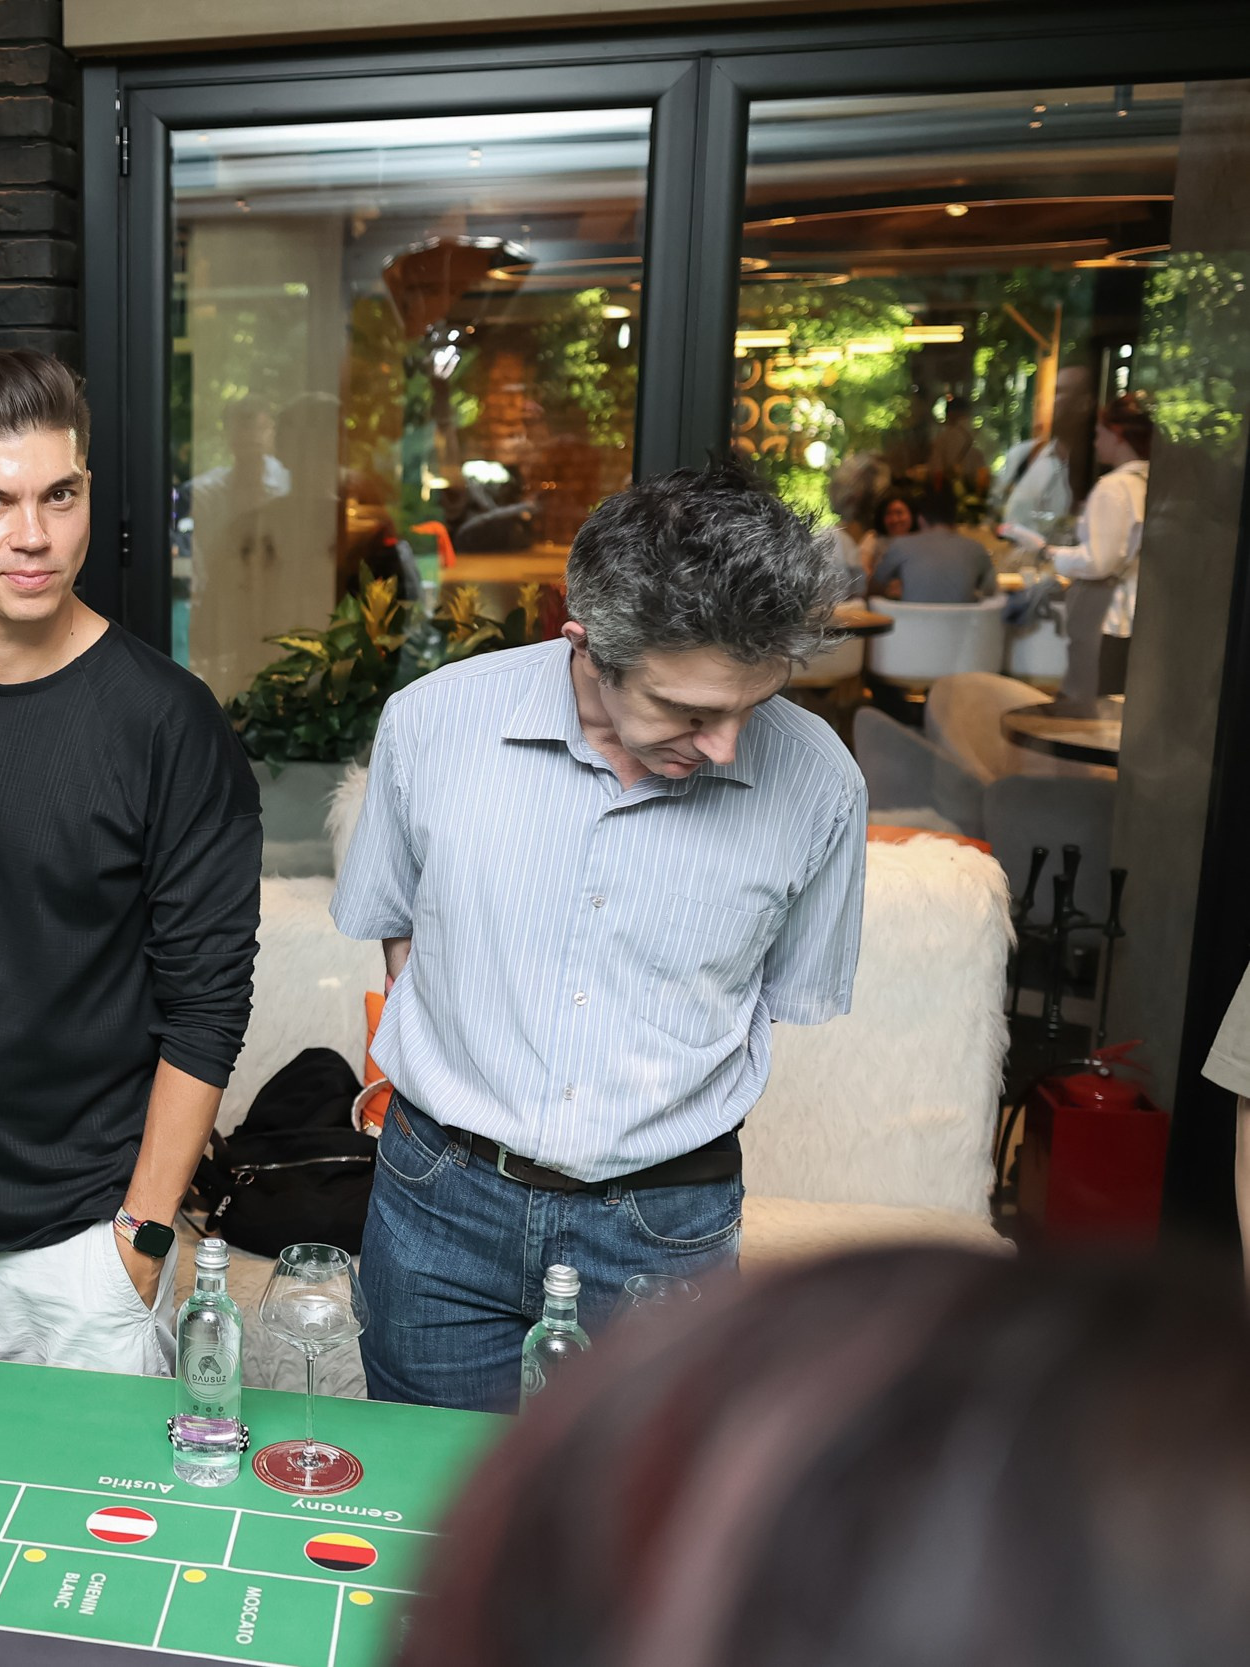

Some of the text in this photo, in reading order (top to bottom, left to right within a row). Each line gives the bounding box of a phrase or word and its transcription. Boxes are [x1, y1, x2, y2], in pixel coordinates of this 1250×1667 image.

[192, 1374, 226, 1383] DAUSUZ
[98, 1475, 175, 1494] Austria
[291, 1497, 403, 1523] Germany
[53, 1572, 81, 1610] BLANC
[78, 1572, 108, 1616] CHENIN
[235, 1585, 263, 1646] MOSCATO
